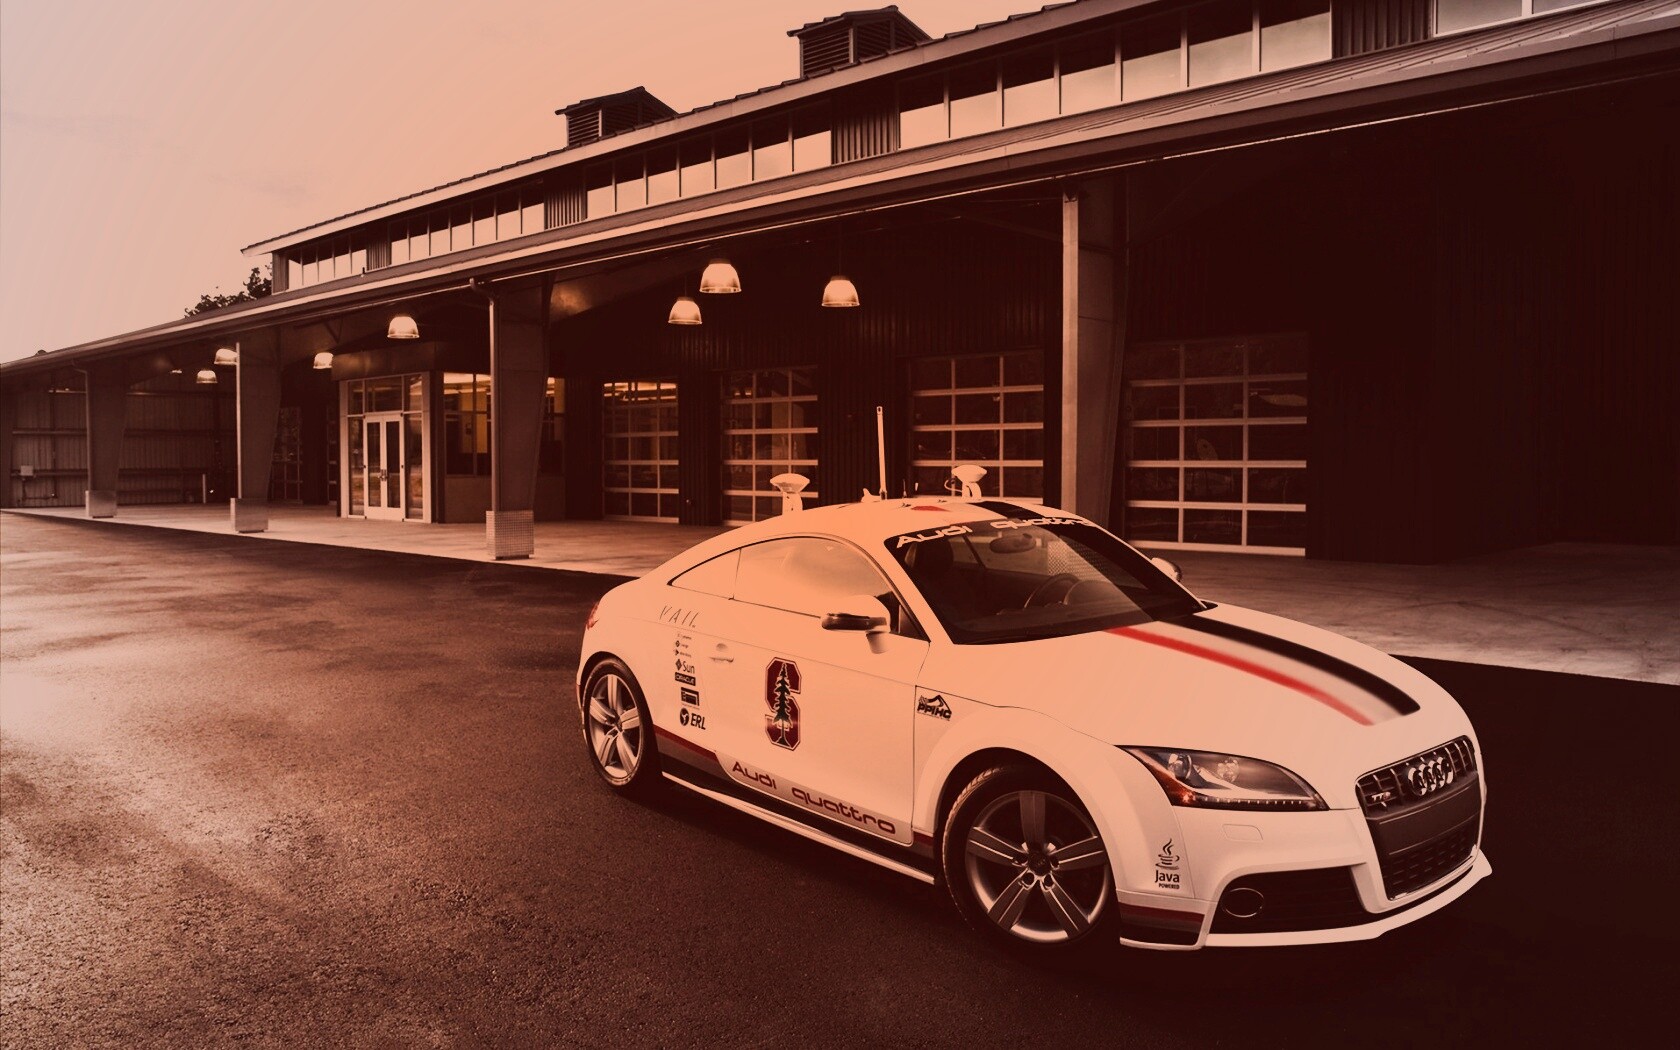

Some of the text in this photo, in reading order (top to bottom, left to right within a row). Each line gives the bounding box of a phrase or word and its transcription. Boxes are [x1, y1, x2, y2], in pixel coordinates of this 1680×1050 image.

[896, 524, 974, 549] Audi
[683, 661, 695, 674] Sun
[917, 703, 952, 719] PPIHC
[691, 713, 706, 730] ERL
[732, 761, 896, 835] Audi quattro
[1154, 869, 1180, 883] Java
